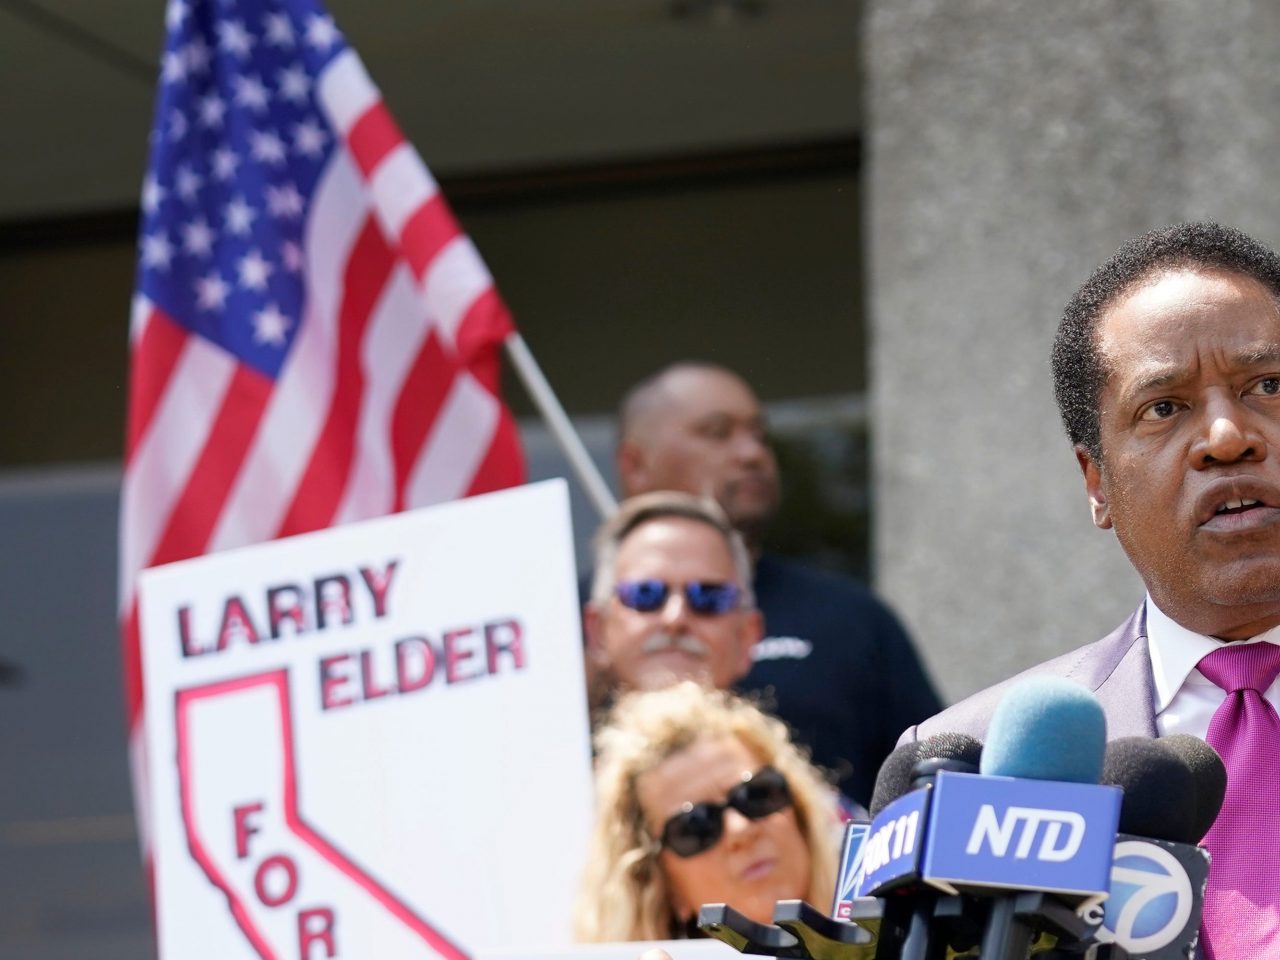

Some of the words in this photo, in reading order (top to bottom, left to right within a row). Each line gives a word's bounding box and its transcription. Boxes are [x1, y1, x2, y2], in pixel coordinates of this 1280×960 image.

[177, 560, 399, 658] LARRY
[319, 618, 525, 711] ELDER
[966, 804, 1087, 863] NTD
